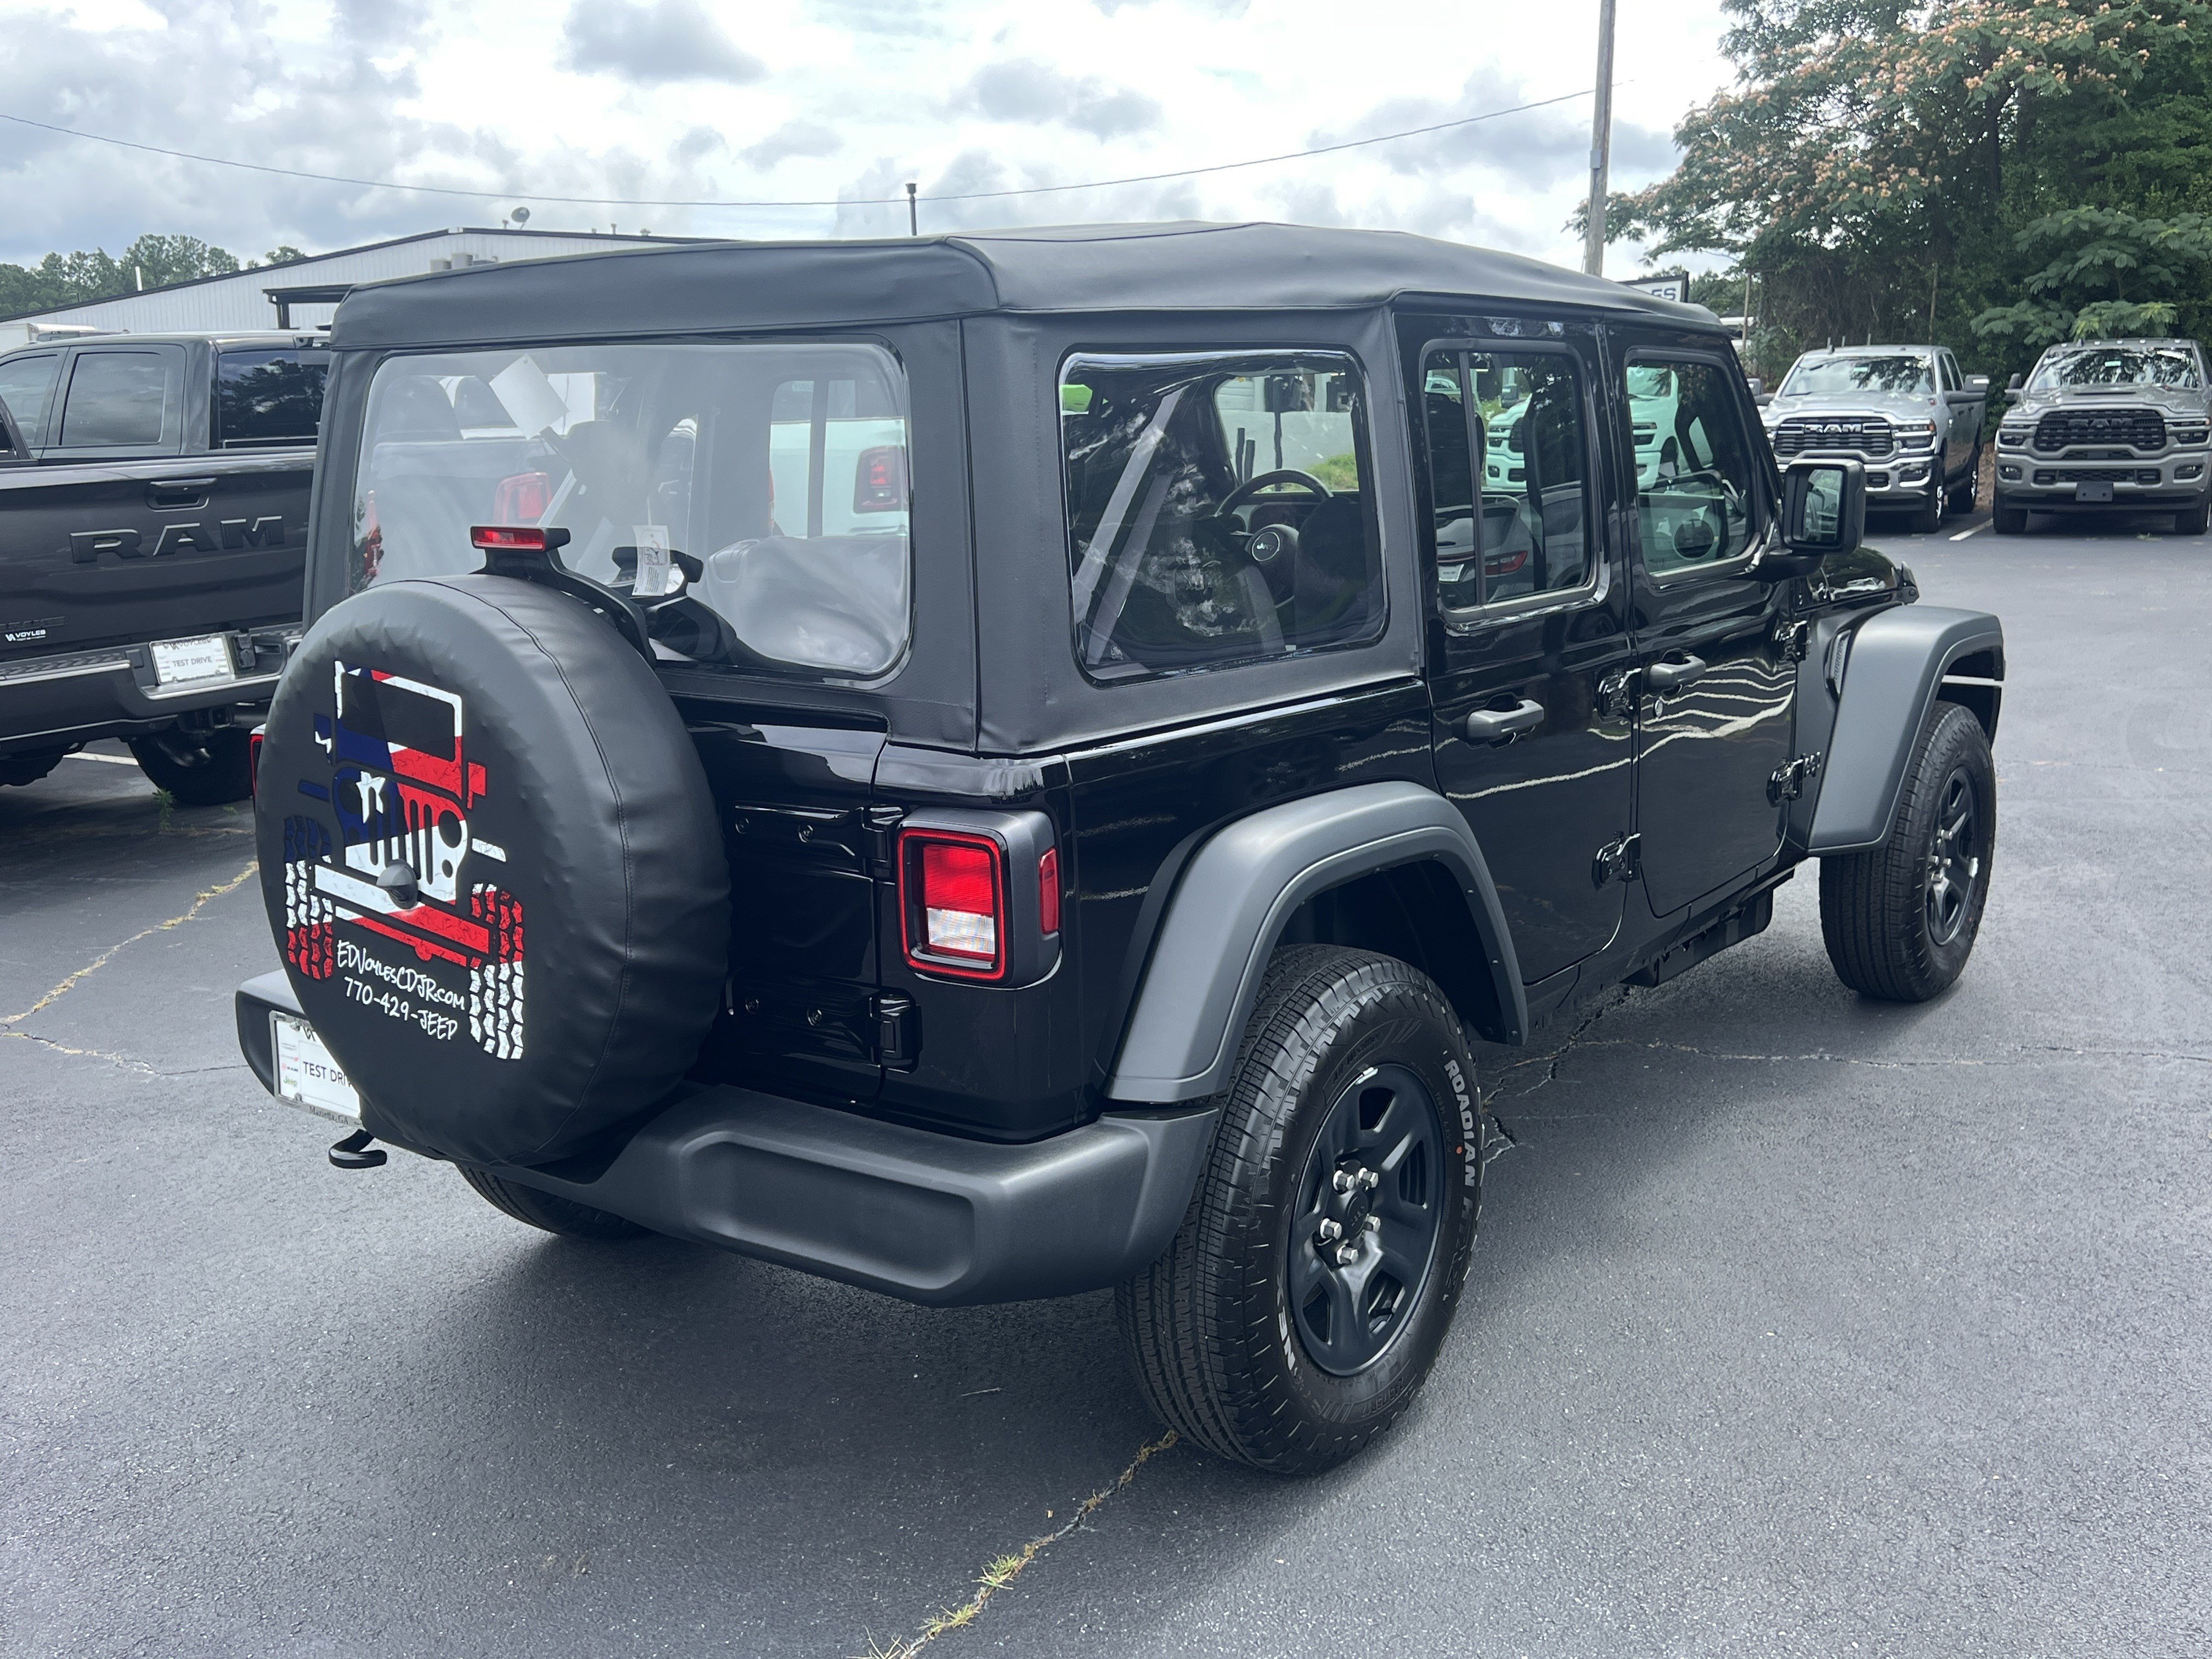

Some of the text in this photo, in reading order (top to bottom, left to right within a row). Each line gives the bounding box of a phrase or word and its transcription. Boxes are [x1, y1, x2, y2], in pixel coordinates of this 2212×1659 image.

[1805, 424, 1861, 433] RAM
[2068, 418, 2132, 428] RAM
[69, 515, 286, 565] RAM
[172, 659, 189, 667] TEST
[191, 656, 212, 665] DRIVE
[344, 976, 458, 1040] 770-429-JEEP
[303, 1061, 327, 1080] TEST
[1443, 1059, 1476, 1187] ROADIAN
